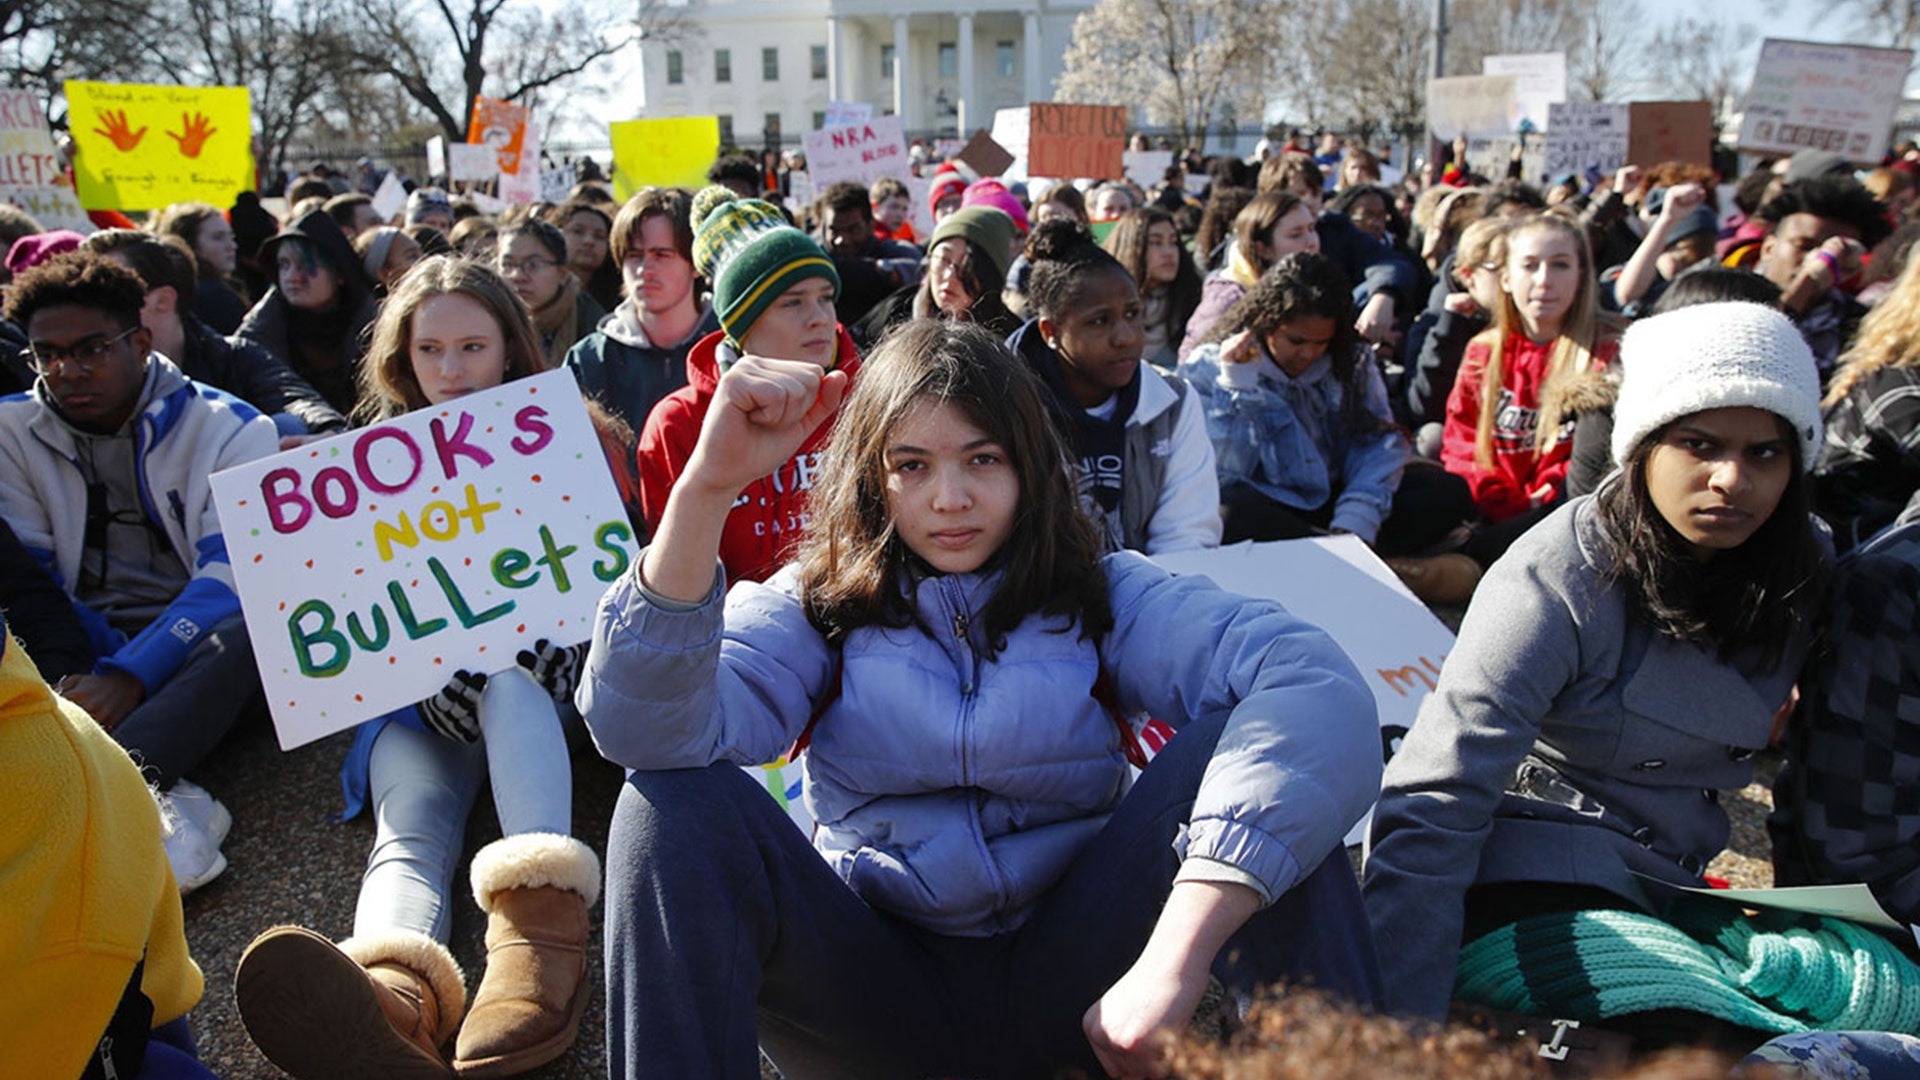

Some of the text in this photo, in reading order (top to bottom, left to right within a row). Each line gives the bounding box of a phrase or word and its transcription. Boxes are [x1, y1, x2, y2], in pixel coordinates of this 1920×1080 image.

[831, 124, 877, 149] NRA
[861, 143, 898, 164] BLOOD
[261, 406, 554, 534] BOOKS
[373, 484, 502, 562] NOT
[288, 520, 631, 679] BULLets
